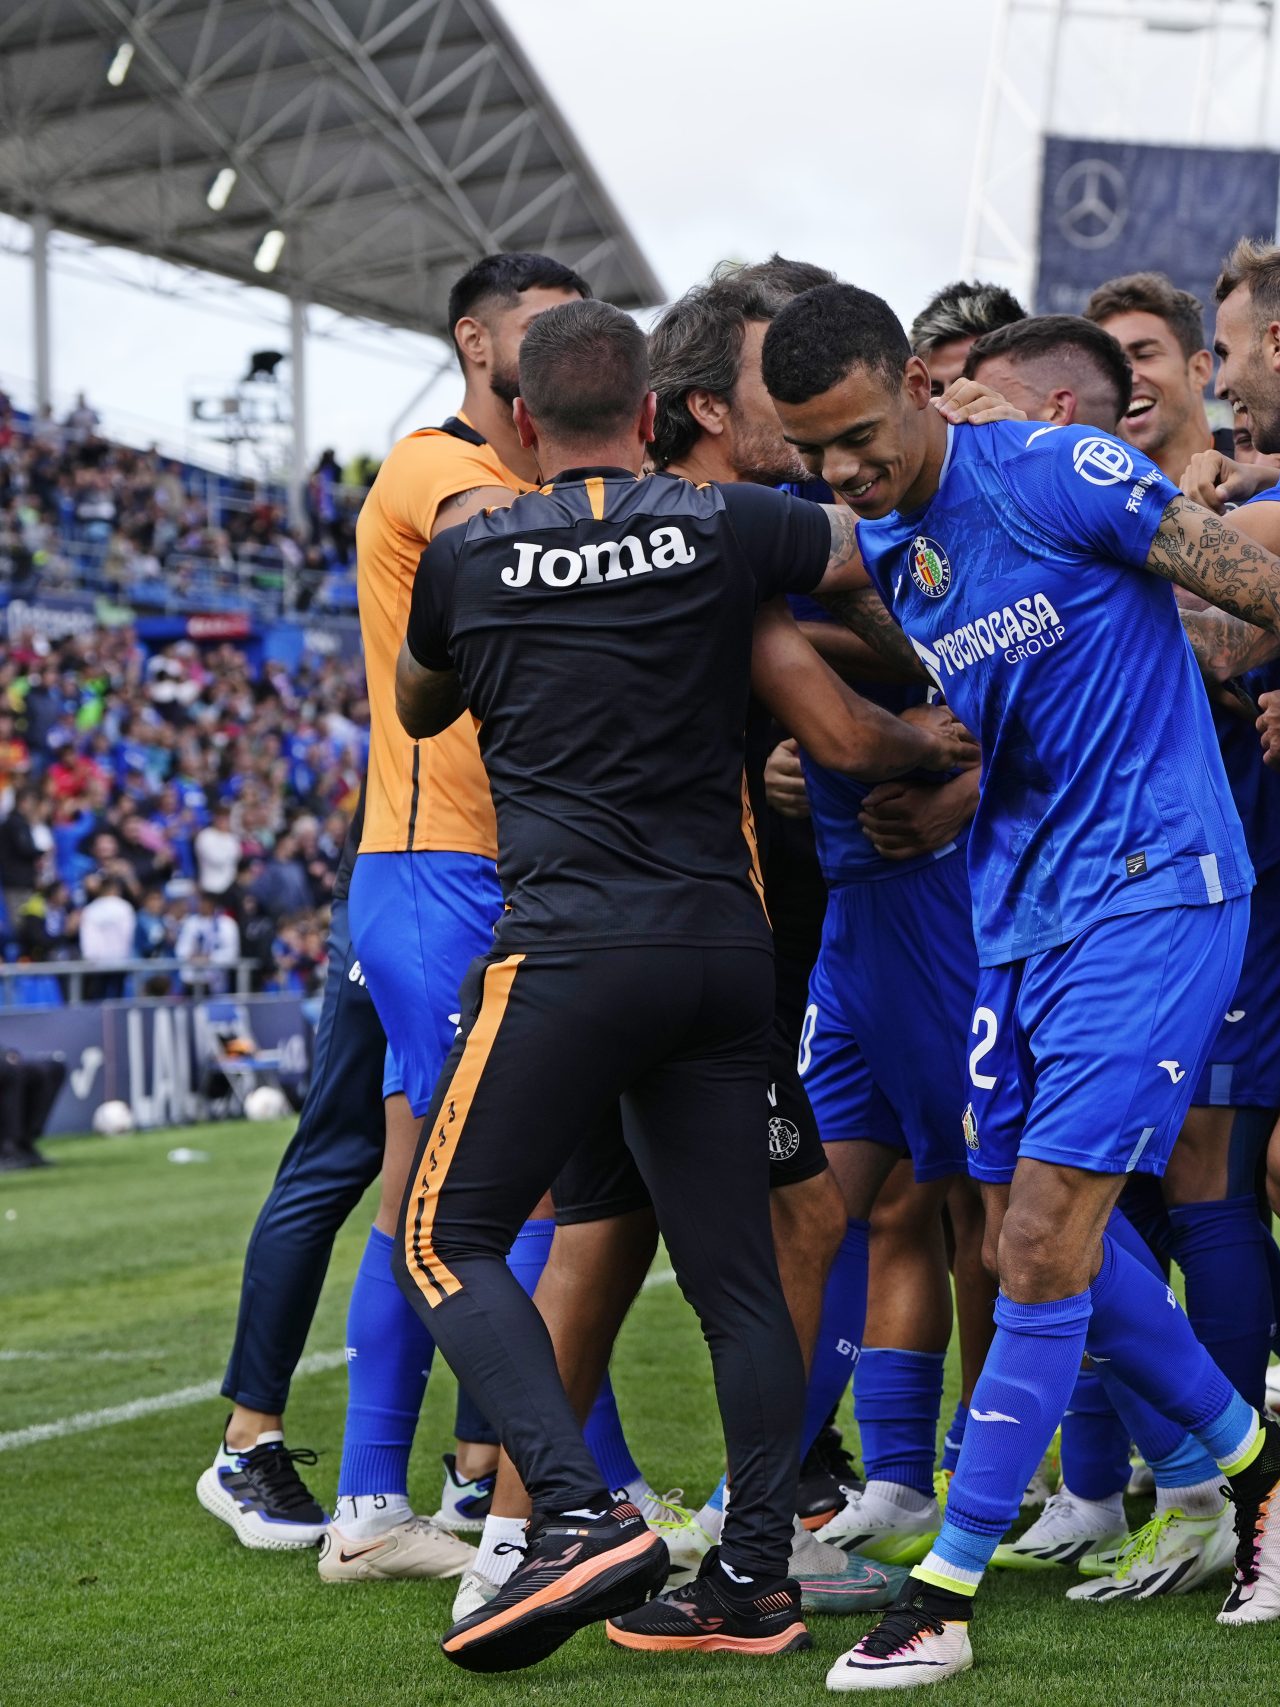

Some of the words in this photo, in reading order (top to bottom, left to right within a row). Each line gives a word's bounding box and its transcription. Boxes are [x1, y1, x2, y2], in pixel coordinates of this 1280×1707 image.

[501, 526, 696, 588] Joma
[932, 593, 1060, 676] TECNOCASA
[1004, 626, 1066, 665] GROUP
[969, 1007, 998, 1090] 2
